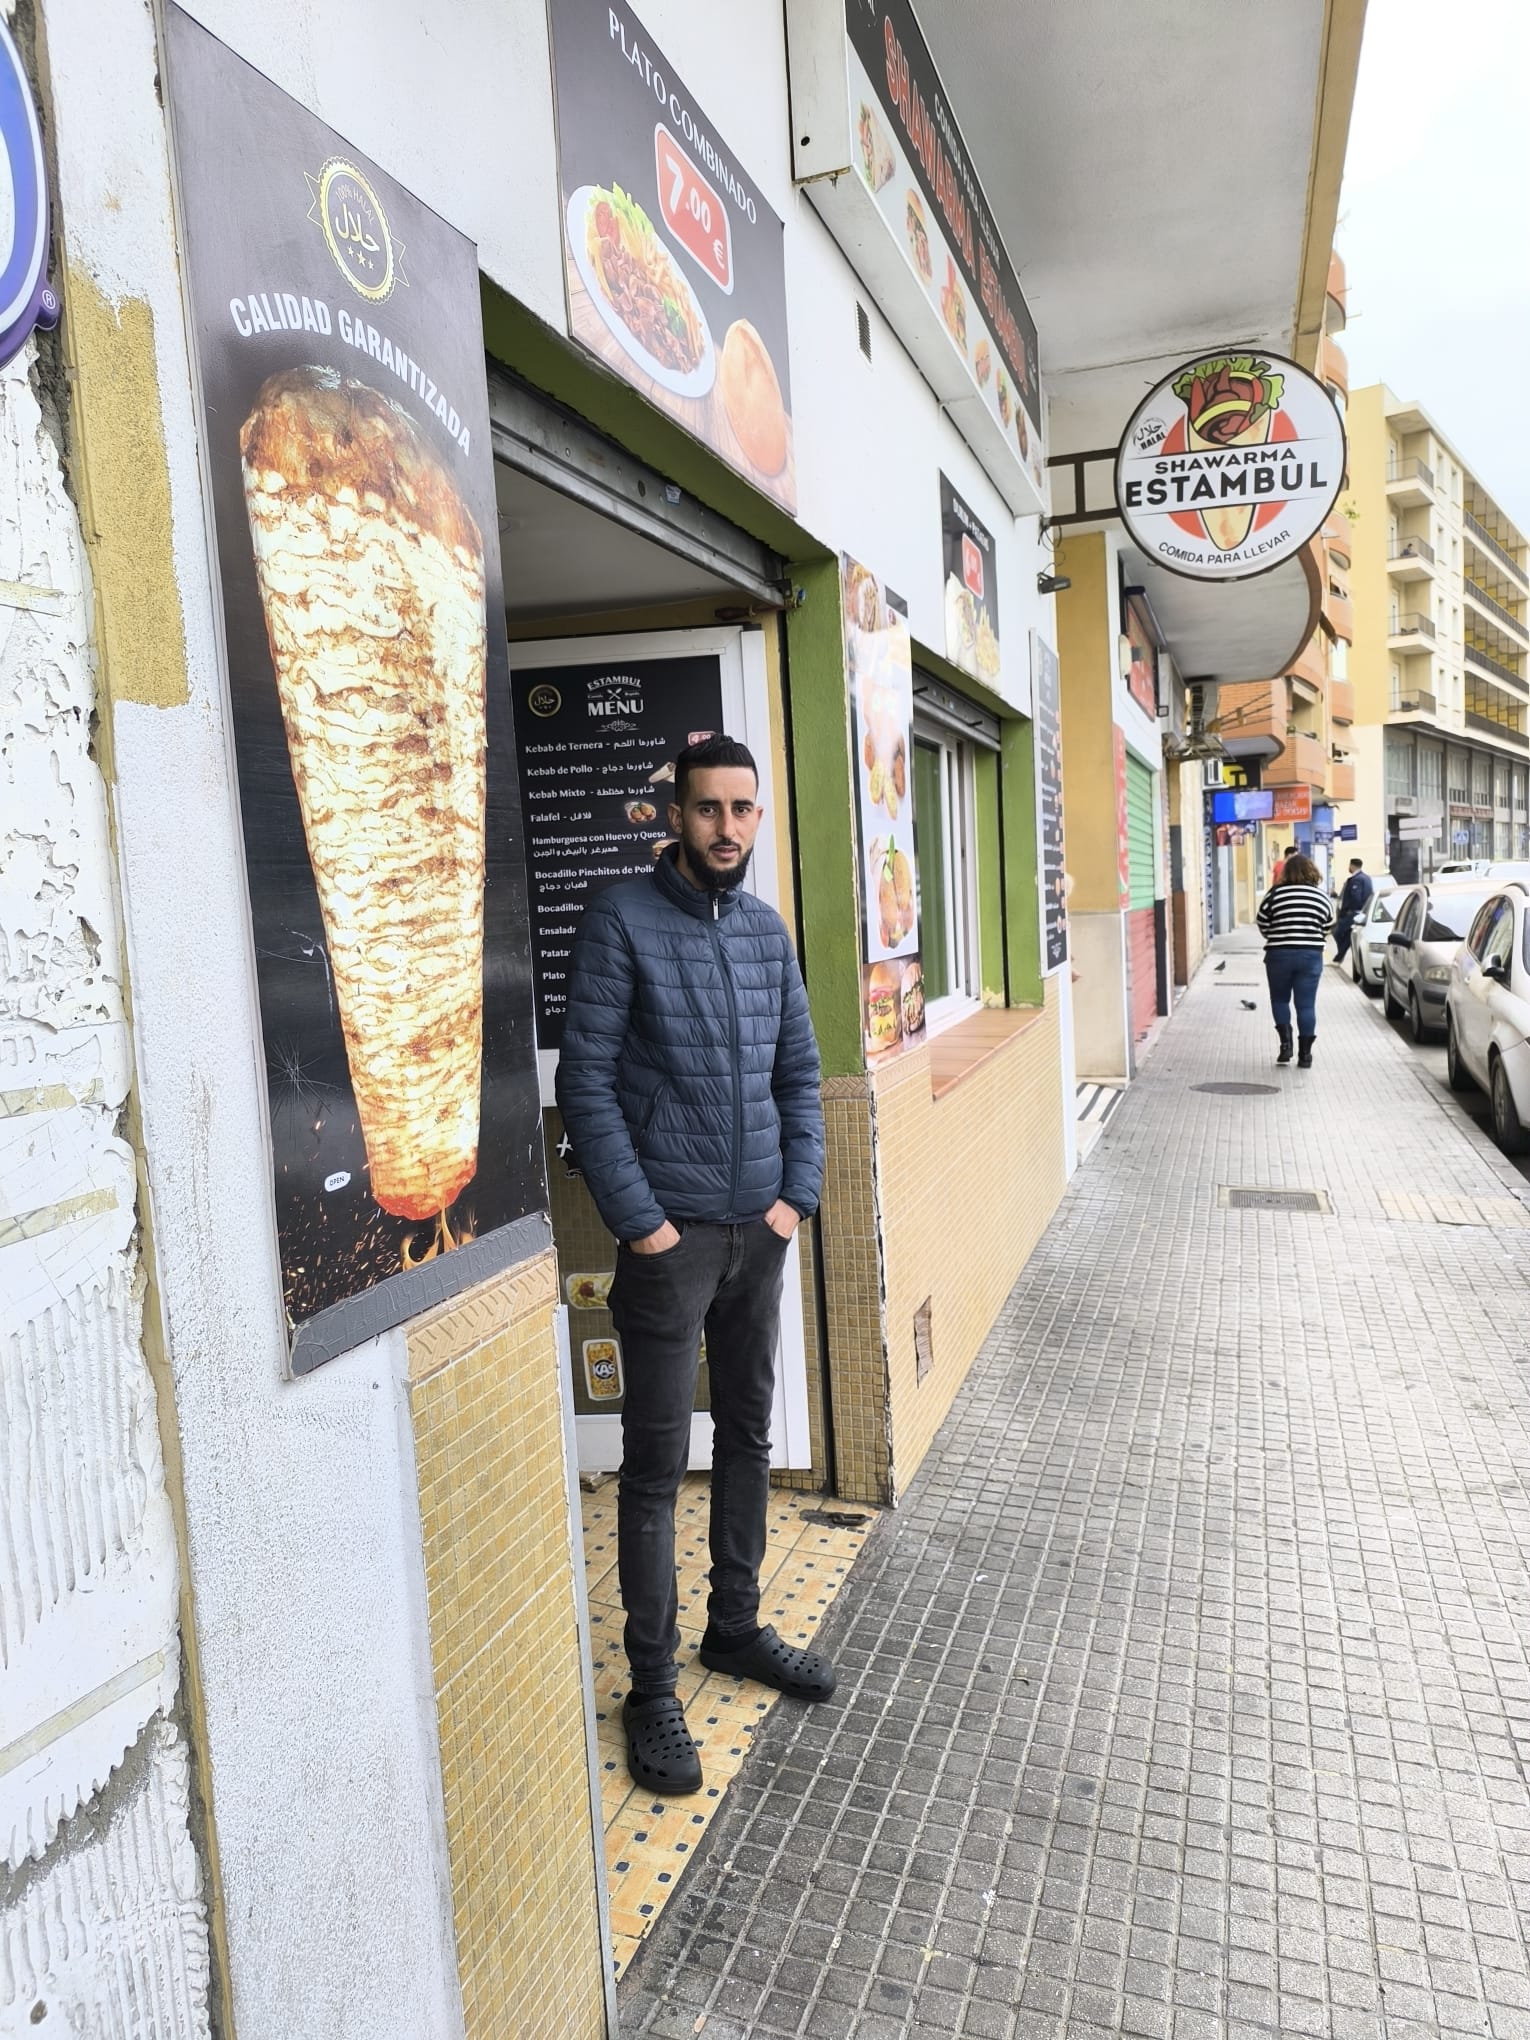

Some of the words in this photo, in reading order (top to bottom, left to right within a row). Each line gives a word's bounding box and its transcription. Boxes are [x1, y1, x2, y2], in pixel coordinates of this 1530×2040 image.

[608, 7, 667, 104] PLATO
[669, 93, 757, 224] COMBINADO
[884, 15, 976, 281] SHAWARMA
[665, 153, 711, 234] 7.00
[335, 203, 381, 251] حلال
[229, 292, 333, 337] CALIDAD
[338, 309, 471, 457] GARANTIZADA
[1140, 433, 1166, 451] HALAL
[1155, 447, 1297, 475] SHAWARMA
[1125, 462, 1328, 508] ESTAMBUL
[1158, 541, 1204, 564] COMIDA
[1207, 552, 1241, 565] PARA
[1244, 529, 1292, 560] LLEVAR
[587, 675, 642, 692] ESTAMBUL
[587, 699, 645, 717] MENU
[555, 743, 567, 752] de
[568, 741, 603, 751] Ternera
[614, 739, 635, 750] اللحم
[638, 737, 666, 747] شاورما
[525, 743, 555, 754] Kebab
[527, 766, 556, 777] Kebab
[557, 765, 569, 775] de
[570, 764, 593, 774] Pollo
[601, 764, 624, 774] دجاج
[626, 761, 654, 771] شاورما
[529, 790, 558, 800] Kebab
[559, 788, 586, 798] Mixto
[628, 785, 655, 796] شاورما
[530, 812, 560, 823] Falafel
[532, 835, 588, 846] Hamburguesa
[589, 834, 605, 842] con
[605, 831, 633, 841] Huevo
[633, 832, 639, 842] y
[640, 830, 667, 840] Queso
[535, 869, 578, 880] Bocadillo
[578, 866, 621, 877] Pinchitos
[621, 865, 633, 874] de
[537, 903, 585, 913] Bocadillos
[541, 950, 571, 958] Patata
[542, 971, 566, 980] Plato
[544, 994, 567, 1002] Plato
[329, 1175, 345, 1186] OPEN
[592, 1363, 616, 1375] KAS
